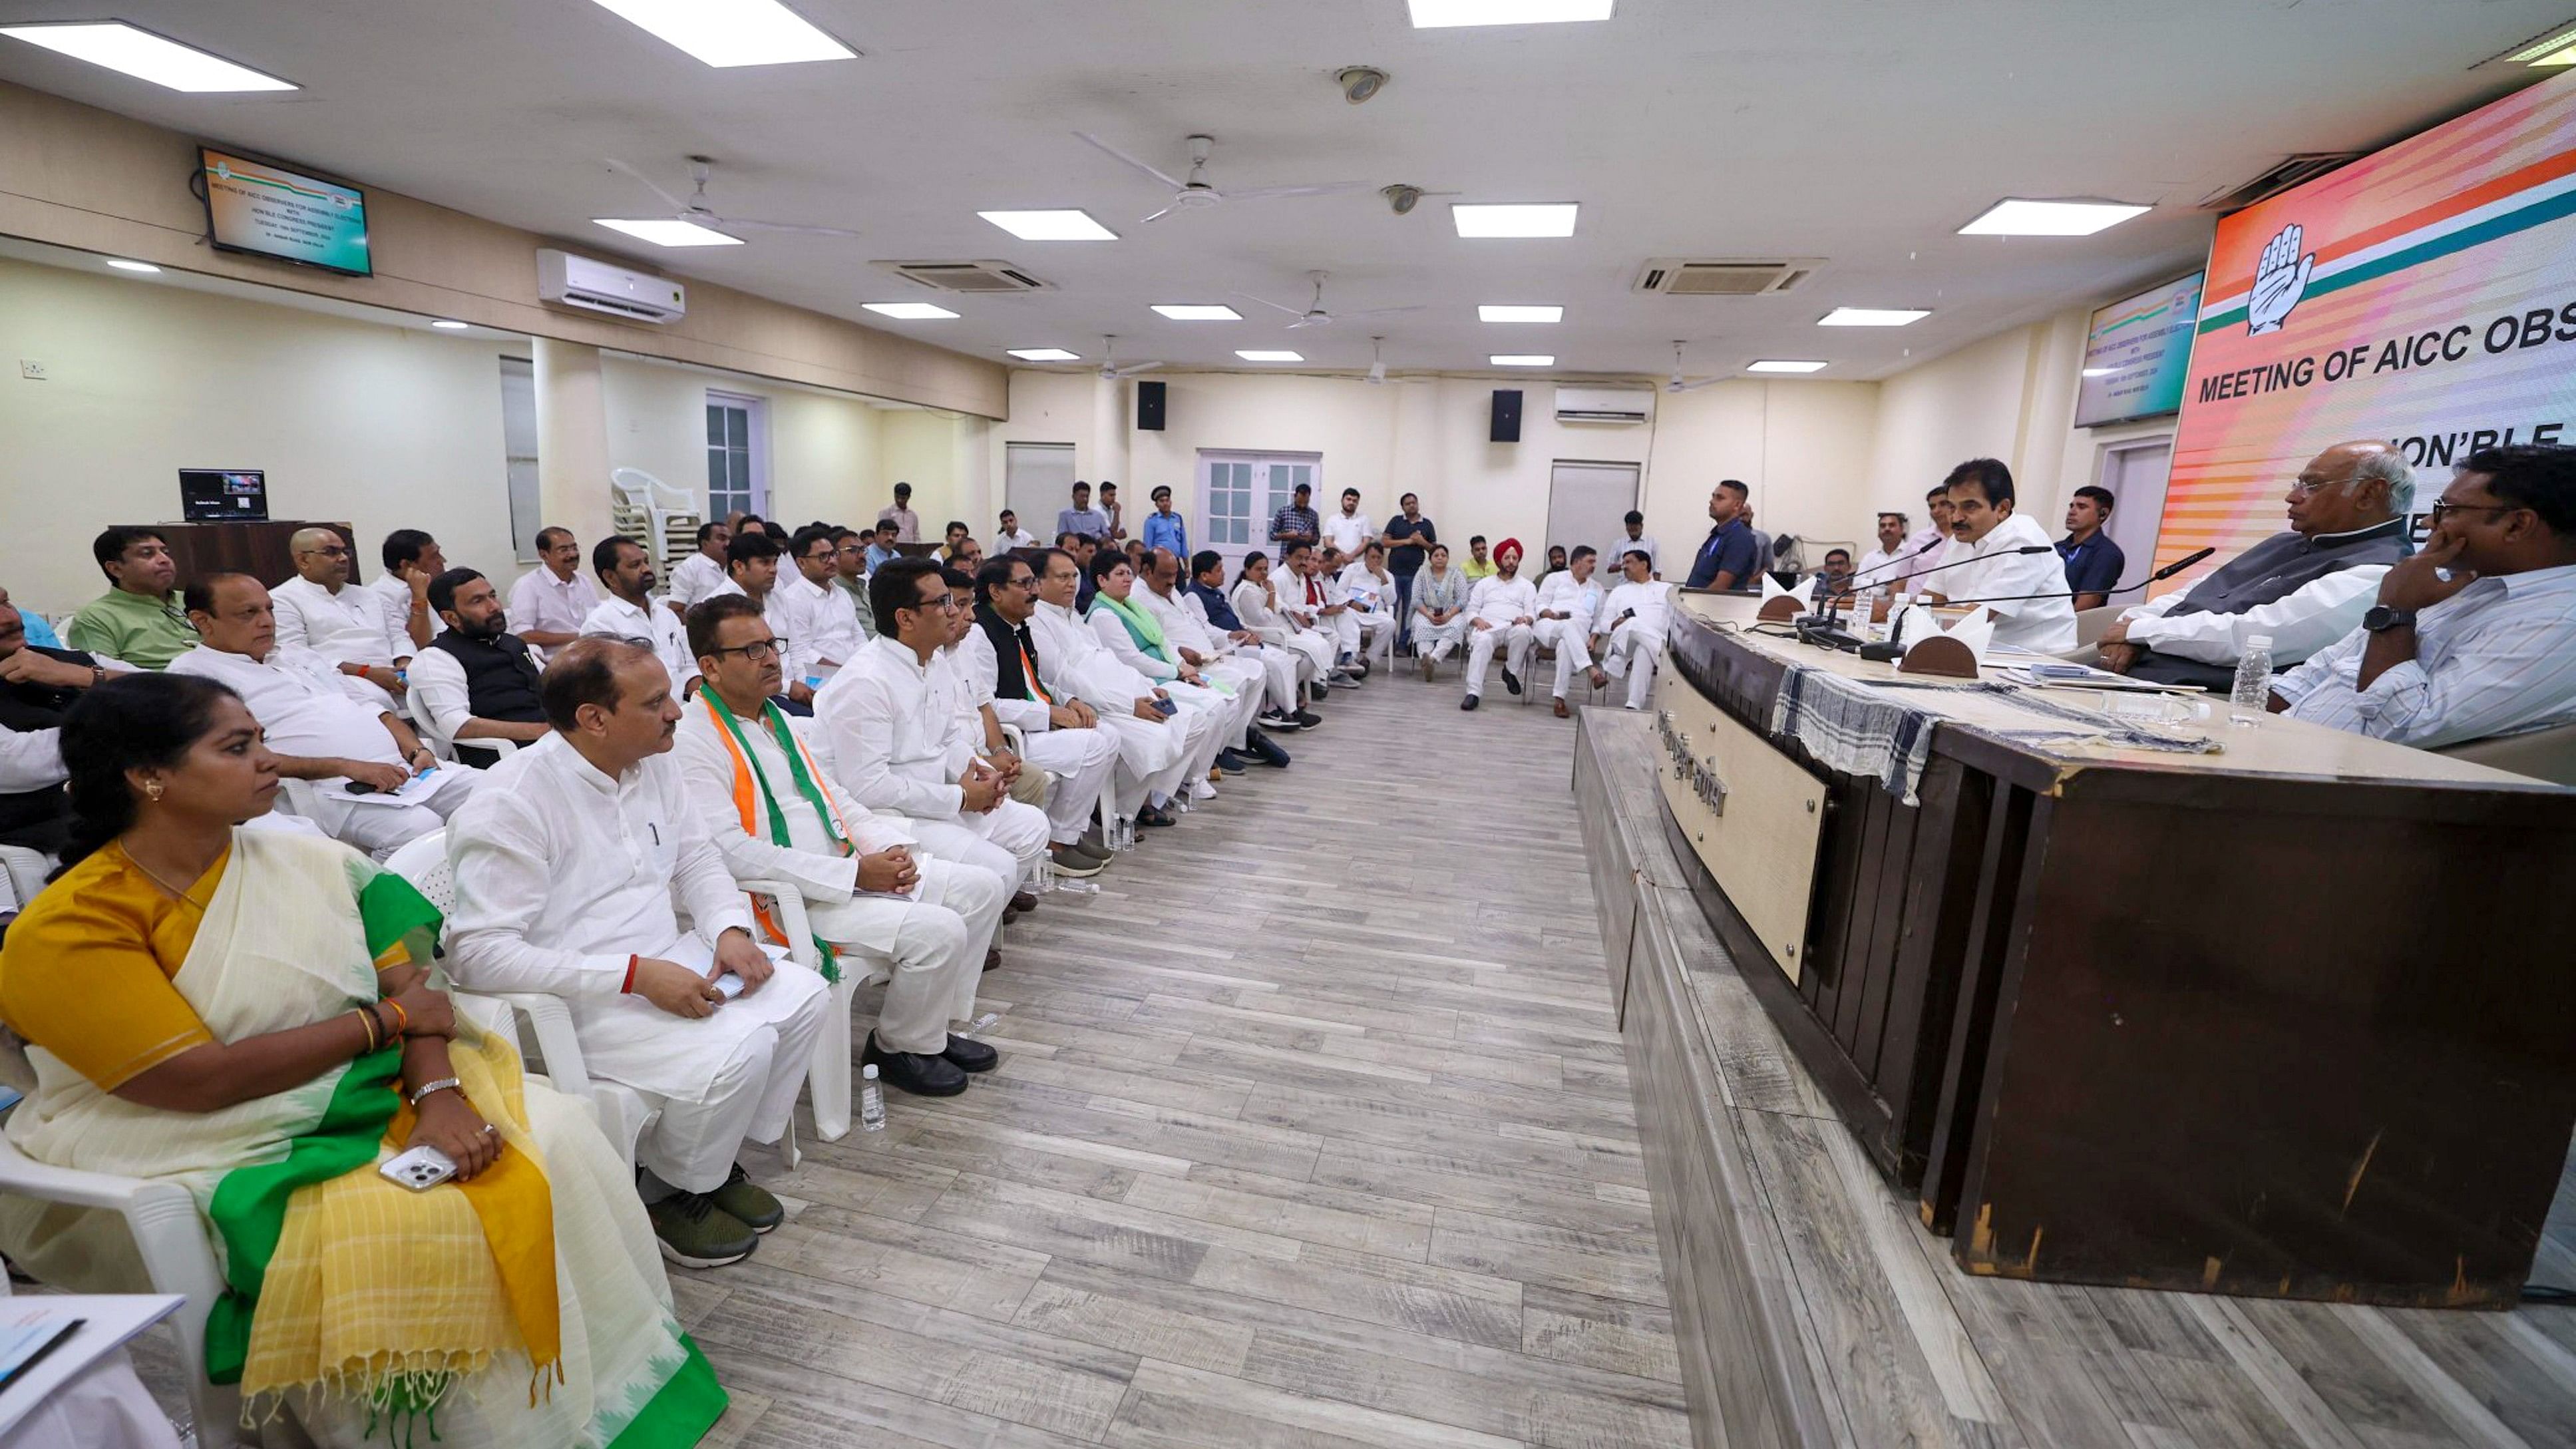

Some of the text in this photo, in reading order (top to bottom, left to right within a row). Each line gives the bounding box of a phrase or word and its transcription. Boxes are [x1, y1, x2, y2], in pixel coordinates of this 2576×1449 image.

[2199, 302, 2576, 403] MEETING OF AICC OBS
[2392, 423, 2564, 467] ON'BE
